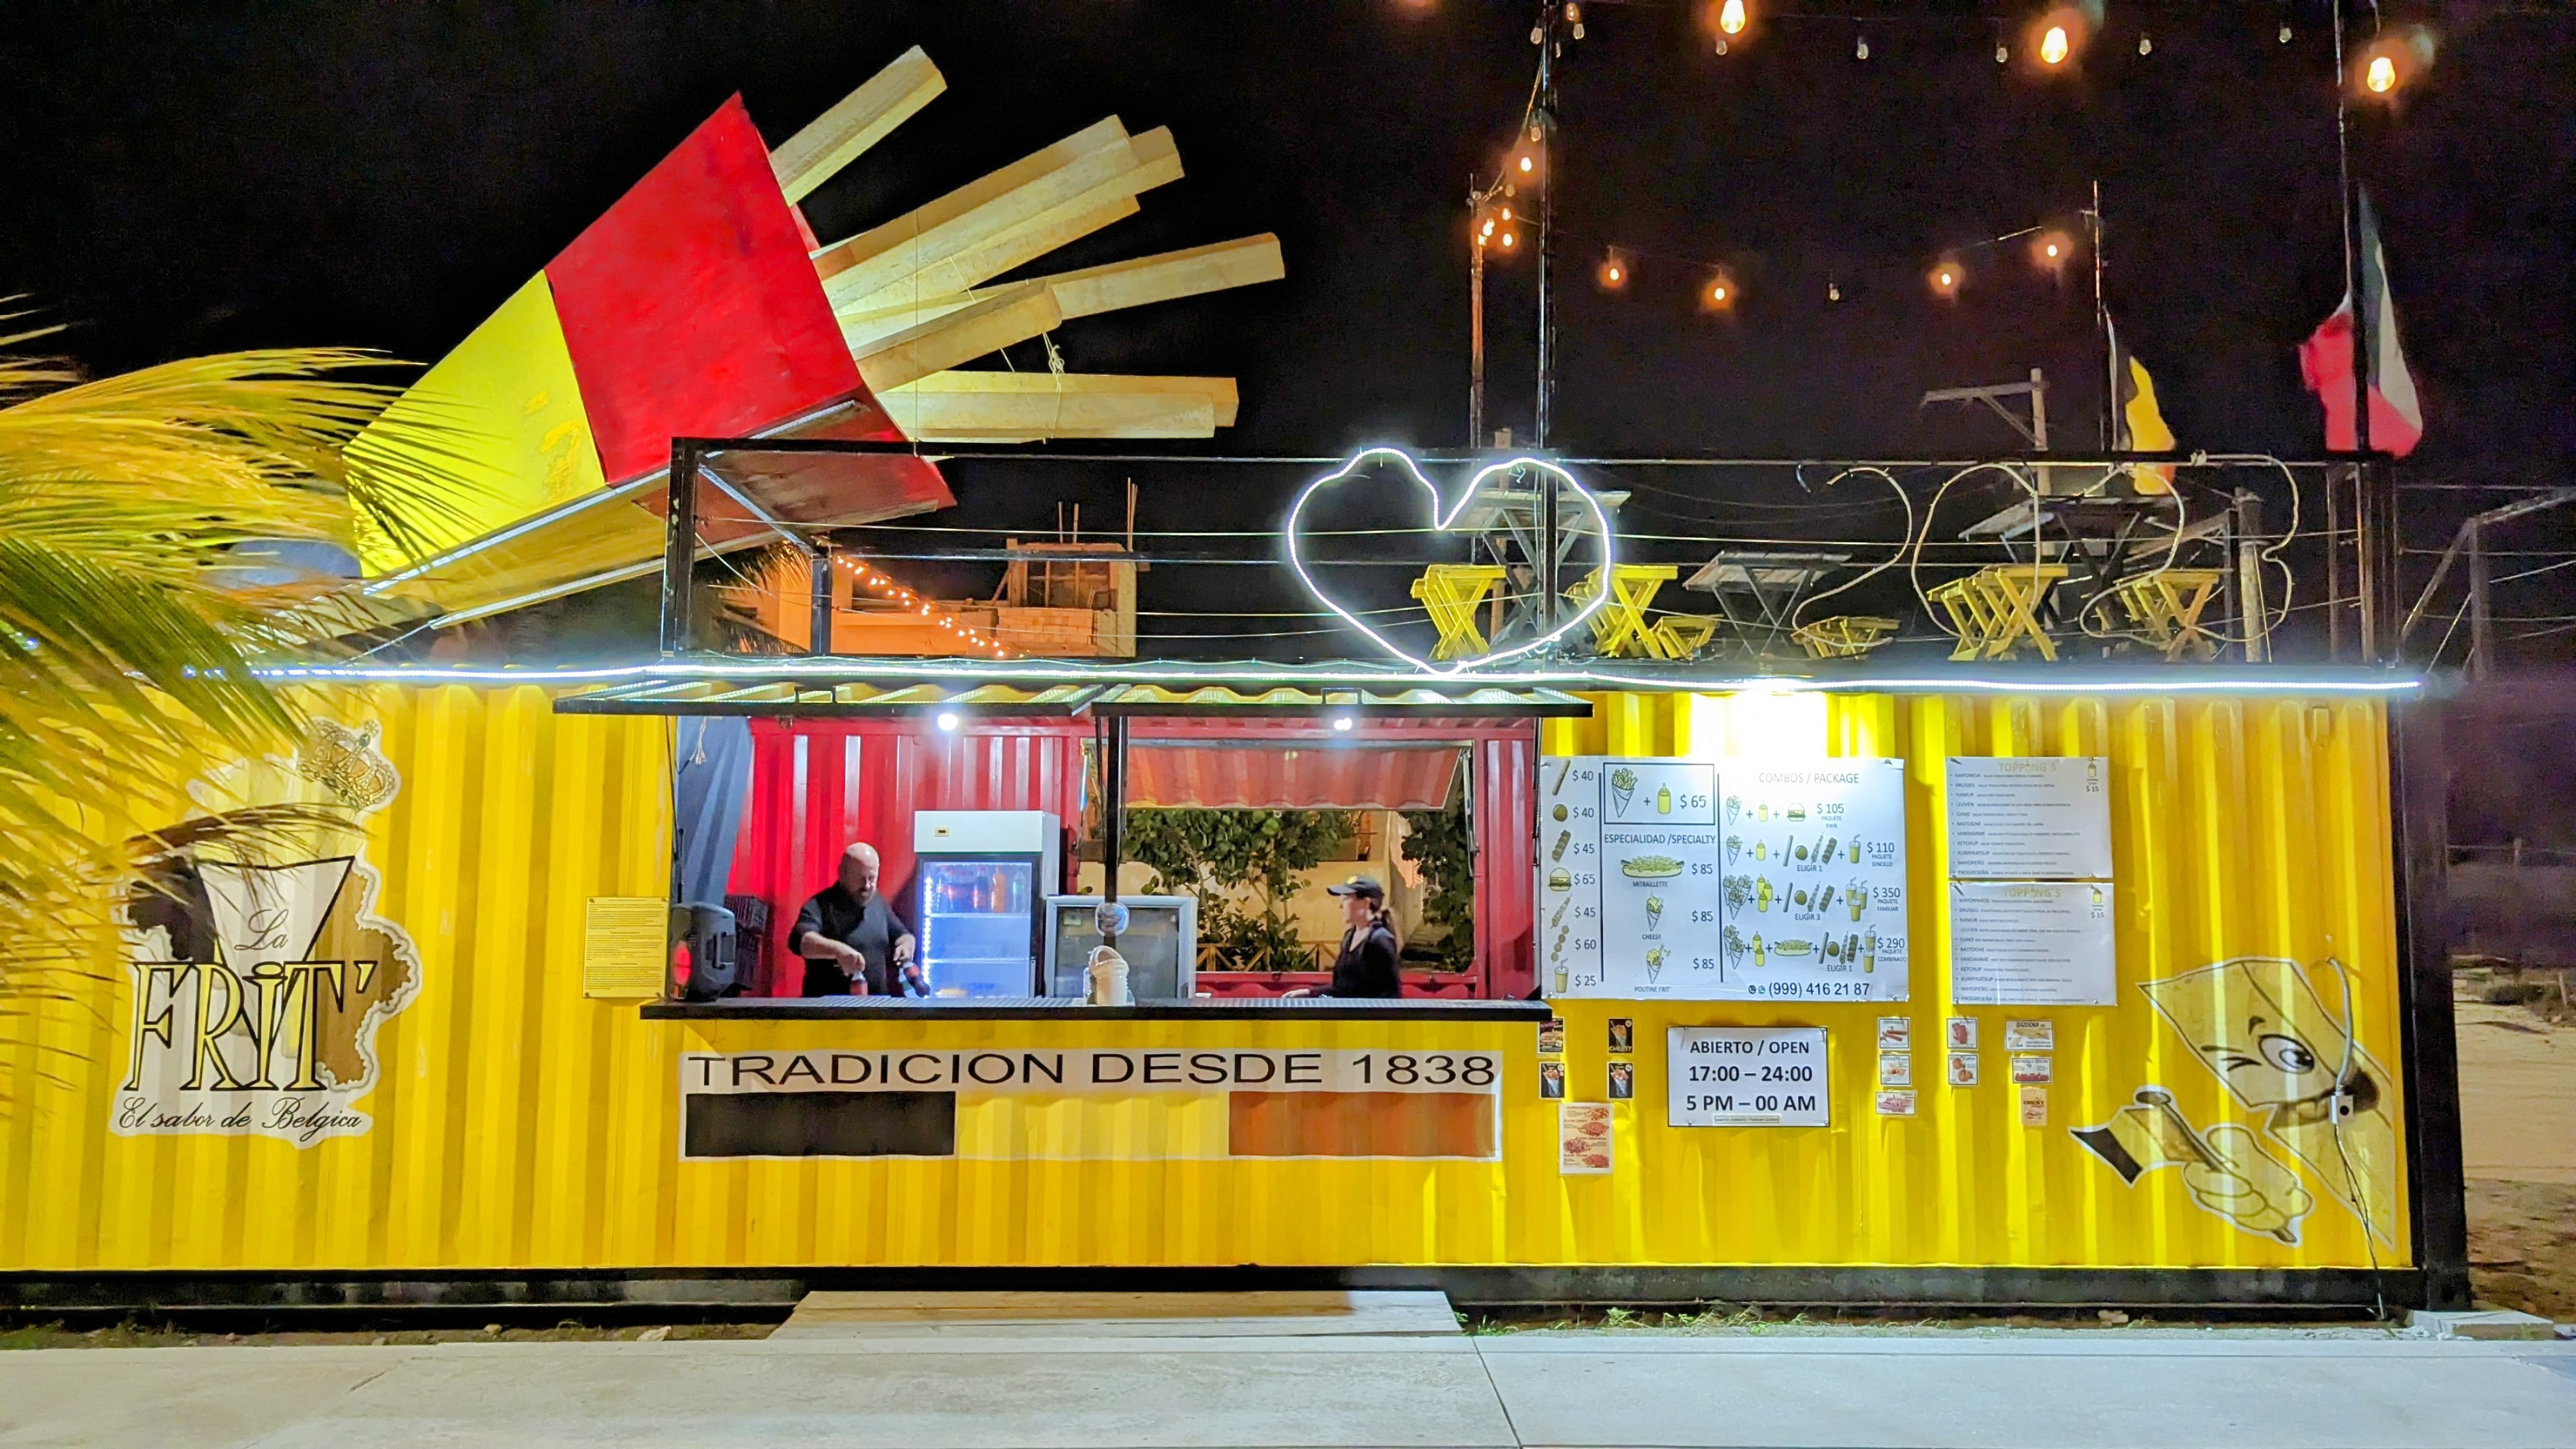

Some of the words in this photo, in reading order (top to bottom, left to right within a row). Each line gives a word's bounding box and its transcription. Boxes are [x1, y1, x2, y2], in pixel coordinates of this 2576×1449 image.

[1572, 770, 1578, 781] $
[1581, 771, 1593, 781] 40
[1759, 773, 1803, 783] COMBOS
[1814, 774, 1859, 783] PACKAGE
[1680, 794, 1687, 809] $
[1691, 796, 1706, 808] 65
[1573, 806, 1579, 818] $
[1582, 808, 1594, 818] 40
[1817, 803, 1823, 815] $
[1827, 804, 1844, 813] 105
[1604, 834, 1665, 843] ESPECIALIDAD
[1574, 843, 1580, 855] $
[1583, 844, 1595, 854] 45
[1867, 841, 1873, 854] $
[1876, 843, 1894, 852] 110
[1692, 863, 1698, 875] $
[1701, 864, 1712, 874] 85
[1574, 873, 1580, 885] $
[1583, 875, 1595, 884] 65
[1873, 887, 1878, 899] $
[1882, 887, 1900, 898] 350
[1575, 906, 1581, 918] $
[1584, 907, 1595, 917] 45
[1692, 910, 1698, 923] $
[1701, 912, 1713, 921] 85
[234, 908, 288, 951] La
[1575, 938, 1581, 950] $
[1584, 940, 1596, 949] 60
[1878, 937, 1883, 949] $
[1887, 939, 1905, 948] 290
[1693, 958, 1699, 970] $
[1702, 959, 1714, 969] 85
[1575, 975, 1581, 987] $
[1584, 976, 1596, 986] 25
[1769, 982, 1802, 997] (999)
[1806, 983, 1830, 995] 416
[1834, 983, 1849, 995] 21
[1854, 983, 1869, 995] 87
[1690, 1041, 1752, 1054] ABIERTO
[1758, 1040, 1764, 1056] /
[1770, 1041, 1809, 1054] OPEN
[688, 1054, 1062, 1085] TRADICION
[1092, 1054, 1322, 1084] DESDE
[1353, 1054, 1494, 1085] 1838
[1689, 1066, 1739, 1081] 17:00
[1762, 1066, 1812, 1081] 24:00
[1687, 1096, 1696, 1110] 5
[1704, 1096, 1733, 1110] PM
[1756, 1096, 1777, 1110] 00
[1784, 1096, 1815, 1110] AM
[119, 1097, 144, 1129] El
[150, 1103, 215, 1129] sabor
[221, 1101, 252, 1130] de
[261, 1097, 361, 1141] Belgica
